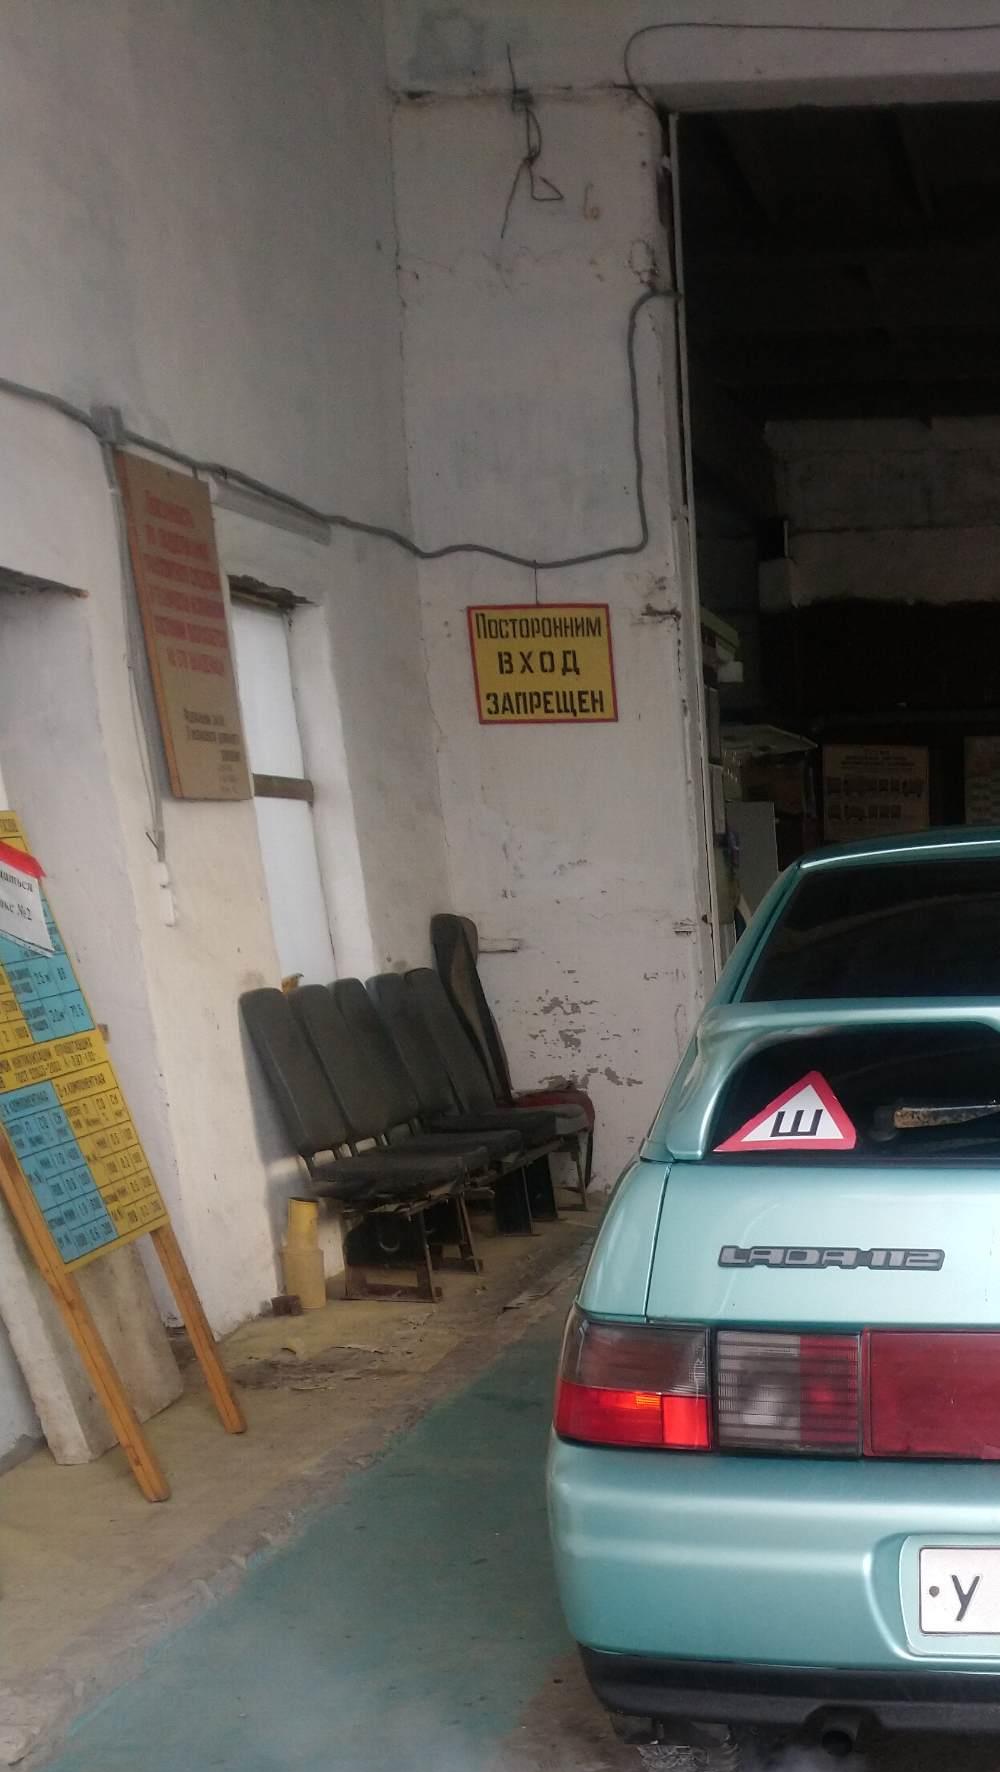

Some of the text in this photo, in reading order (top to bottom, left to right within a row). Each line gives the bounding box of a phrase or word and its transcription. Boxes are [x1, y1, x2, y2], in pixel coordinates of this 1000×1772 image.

[497, 649, 581, 676] ВХОД
[485, 690, 605, 717] ЗАПРЕЩЕН
[769, 1108, 824, 1138] Ш
